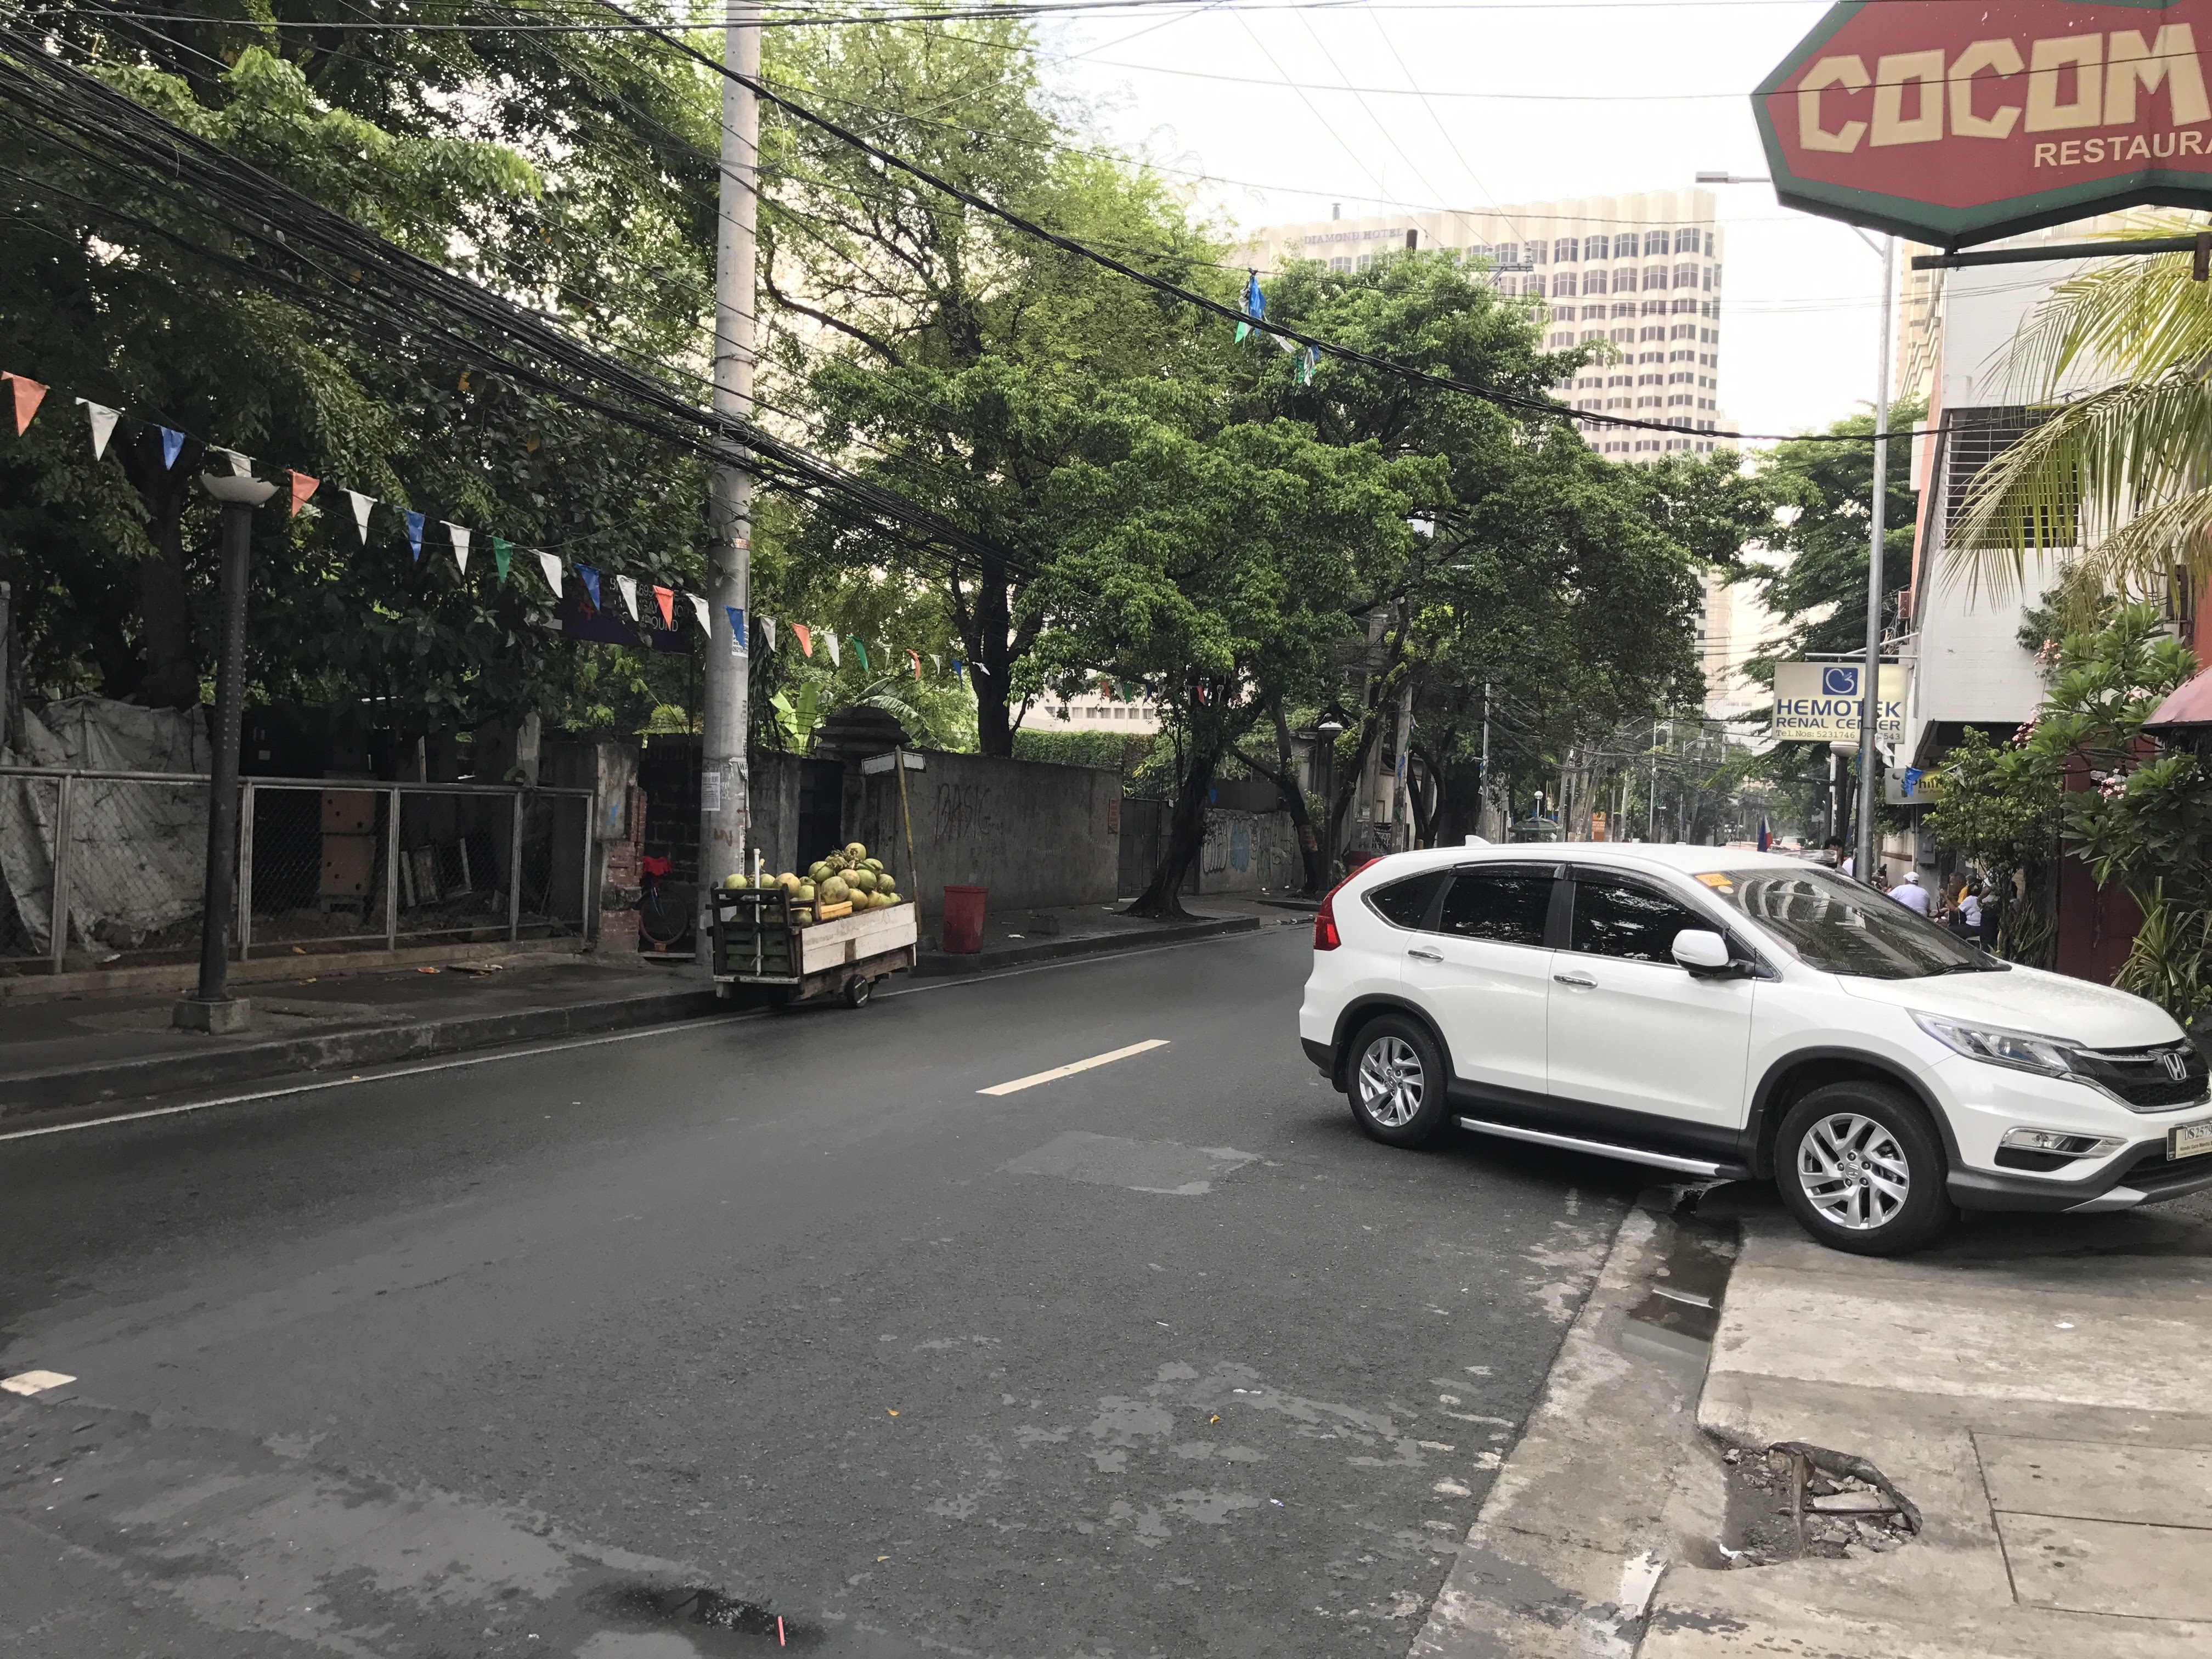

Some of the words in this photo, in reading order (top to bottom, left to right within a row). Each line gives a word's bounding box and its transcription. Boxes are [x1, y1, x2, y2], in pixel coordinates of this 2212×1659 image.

[1304, 232, 1359, 245] DIAMOND
[1363, 228, 1403, 240] HOTEL
[1776, 717, 1829, 729] RENAL
[1836, 719, 1900, 731] CEER
[1816, 731, 1855, 739] 5231746
